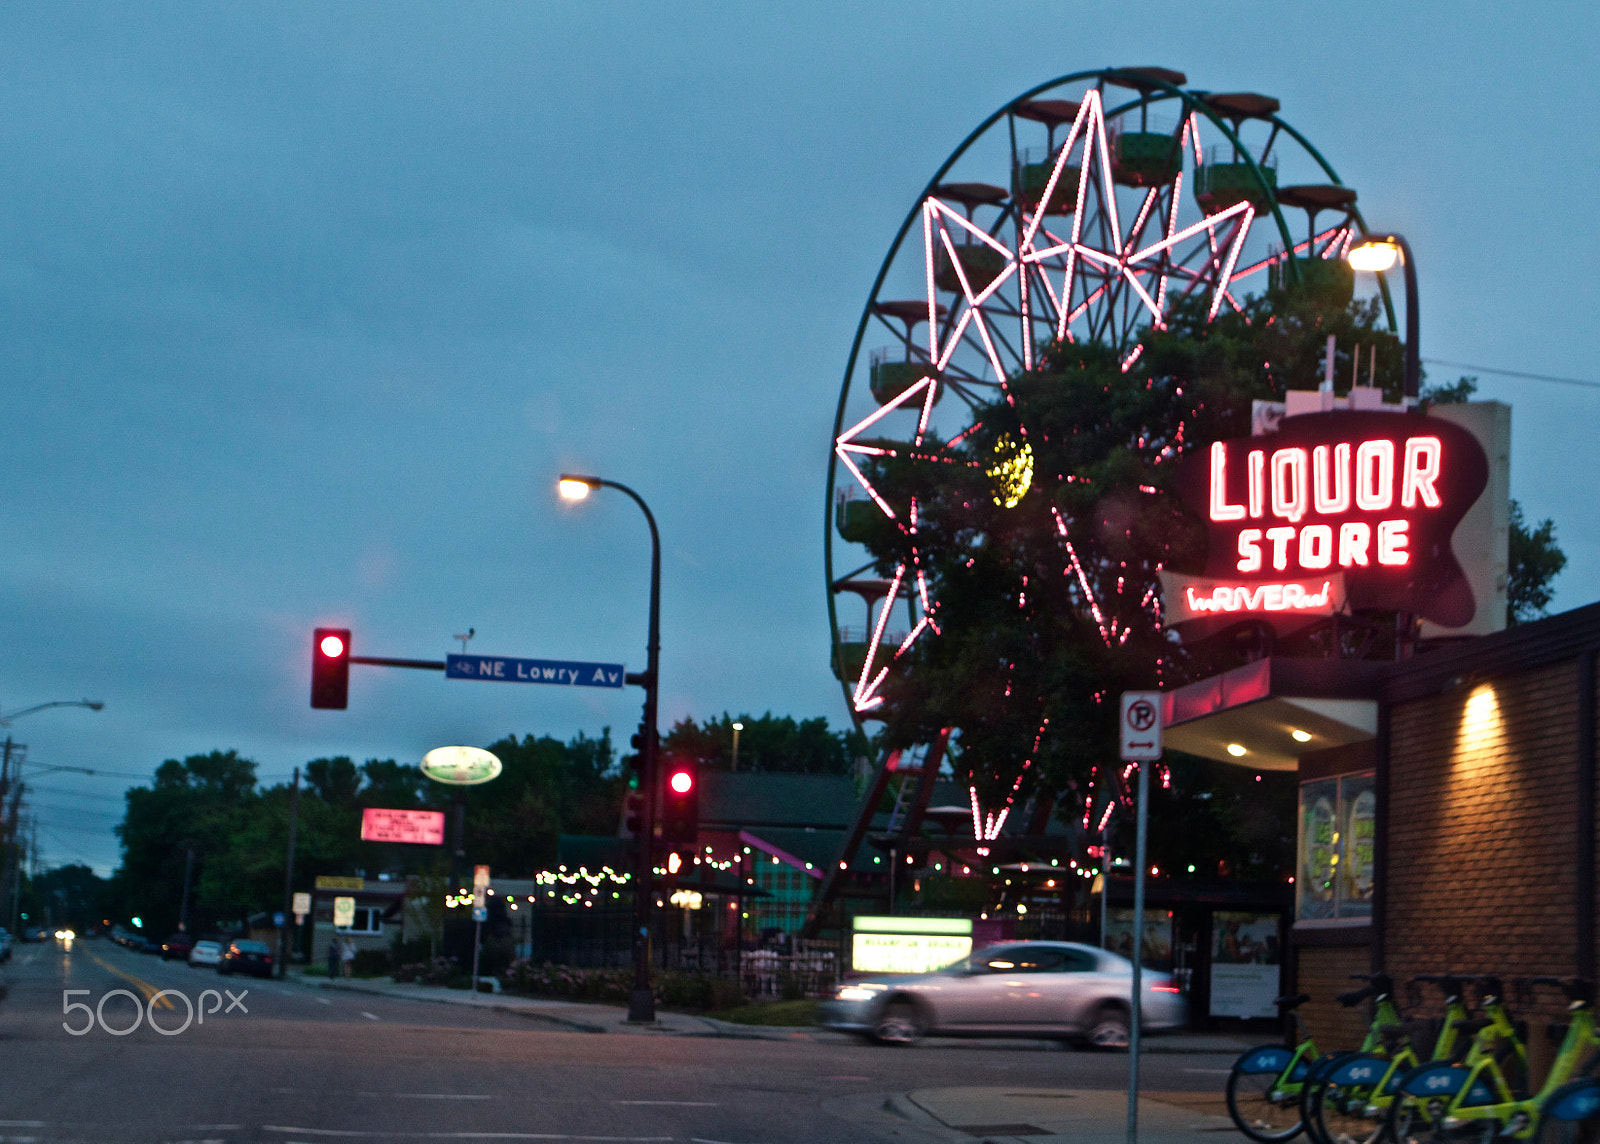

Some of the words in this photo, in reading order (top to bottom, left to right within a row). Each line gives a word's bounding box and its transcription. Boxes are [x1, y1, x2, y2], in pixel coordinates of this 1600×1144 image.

[1210, 437, 1441, 522] LIQUOR
[1237, 519, 1410, 572] STORE
[479, 660, 505, 677] NE
[517, 662, 579, 685] Lowry
[592, 668, 618, 683] Av
